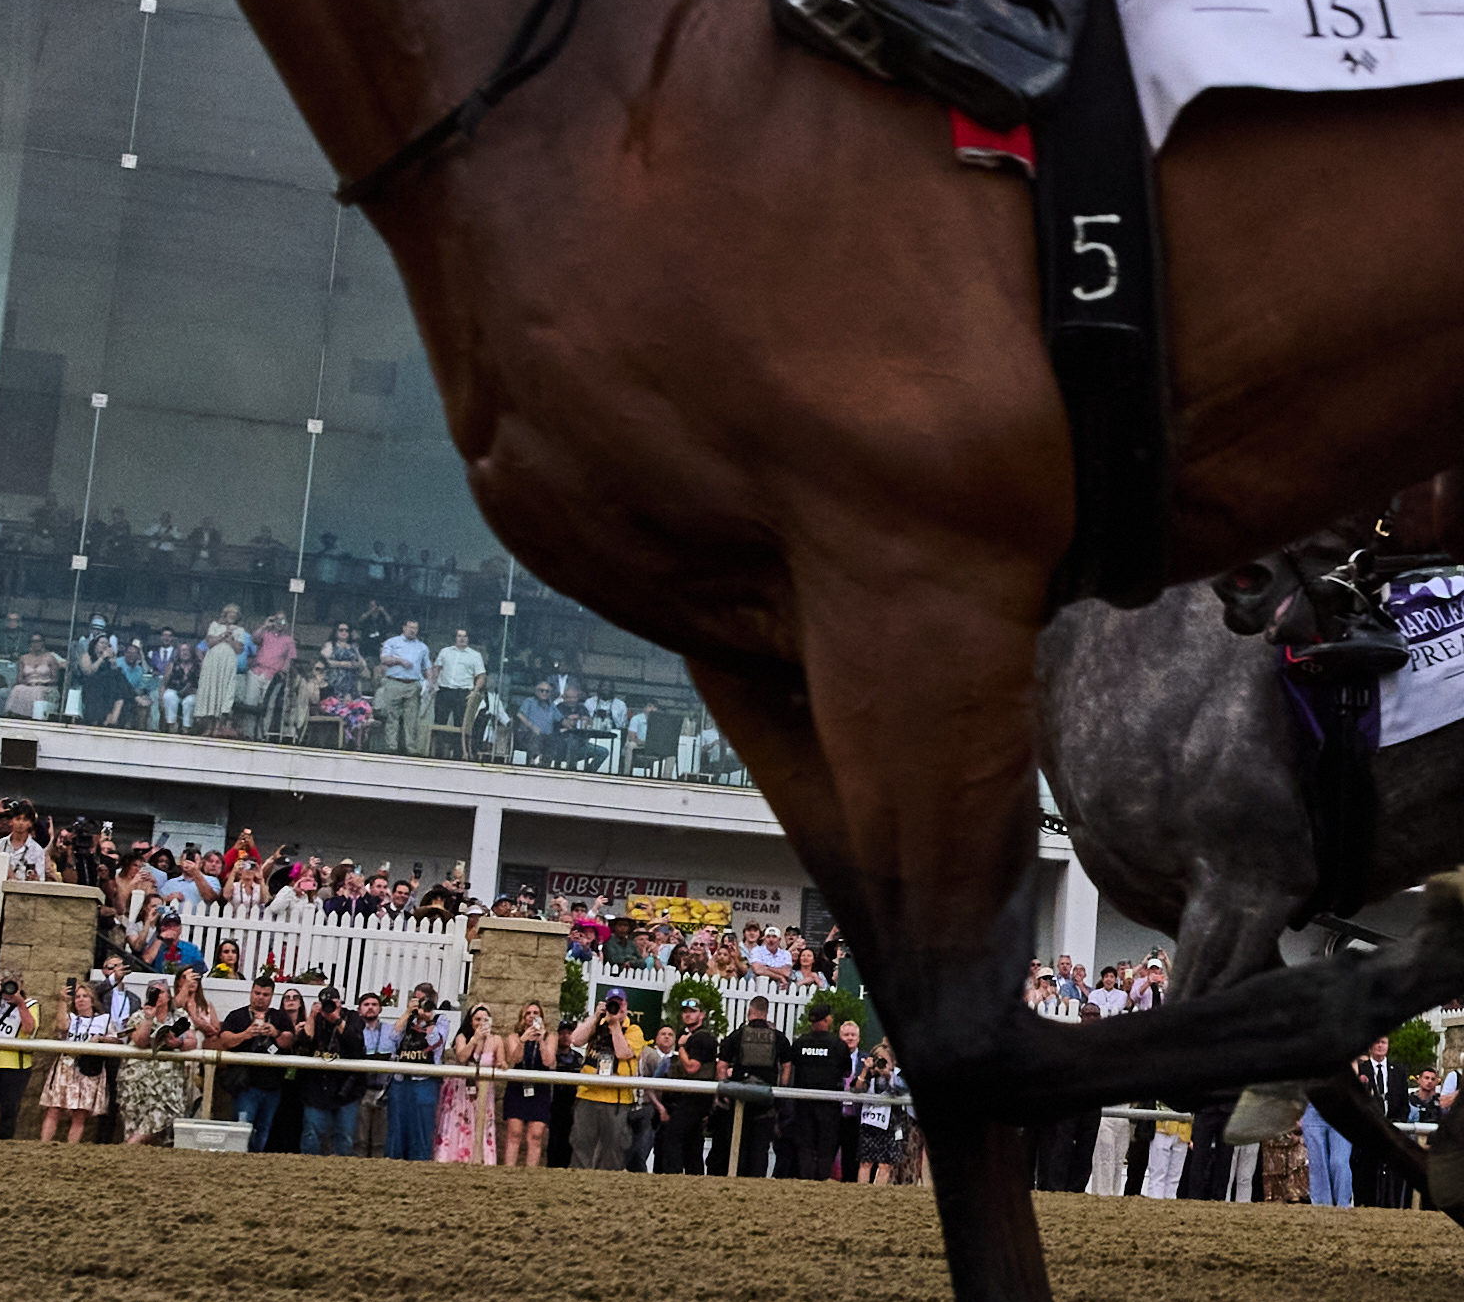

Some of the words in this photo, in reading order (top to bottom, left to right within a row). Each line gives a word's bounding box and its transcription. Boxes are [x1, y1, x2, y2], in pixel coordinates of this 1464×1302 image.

[1072, 213, 1121, 301] 5
[552, 874, 638, 897] LOBSTER
[645, 880, 684, 898] HUT
[706, 885, 767, 900] COOKIES
[771, 891, 781, 900] &
[732, 901, 780, 914] CREAM
[801, 1047, 829, 1057] POLICE
